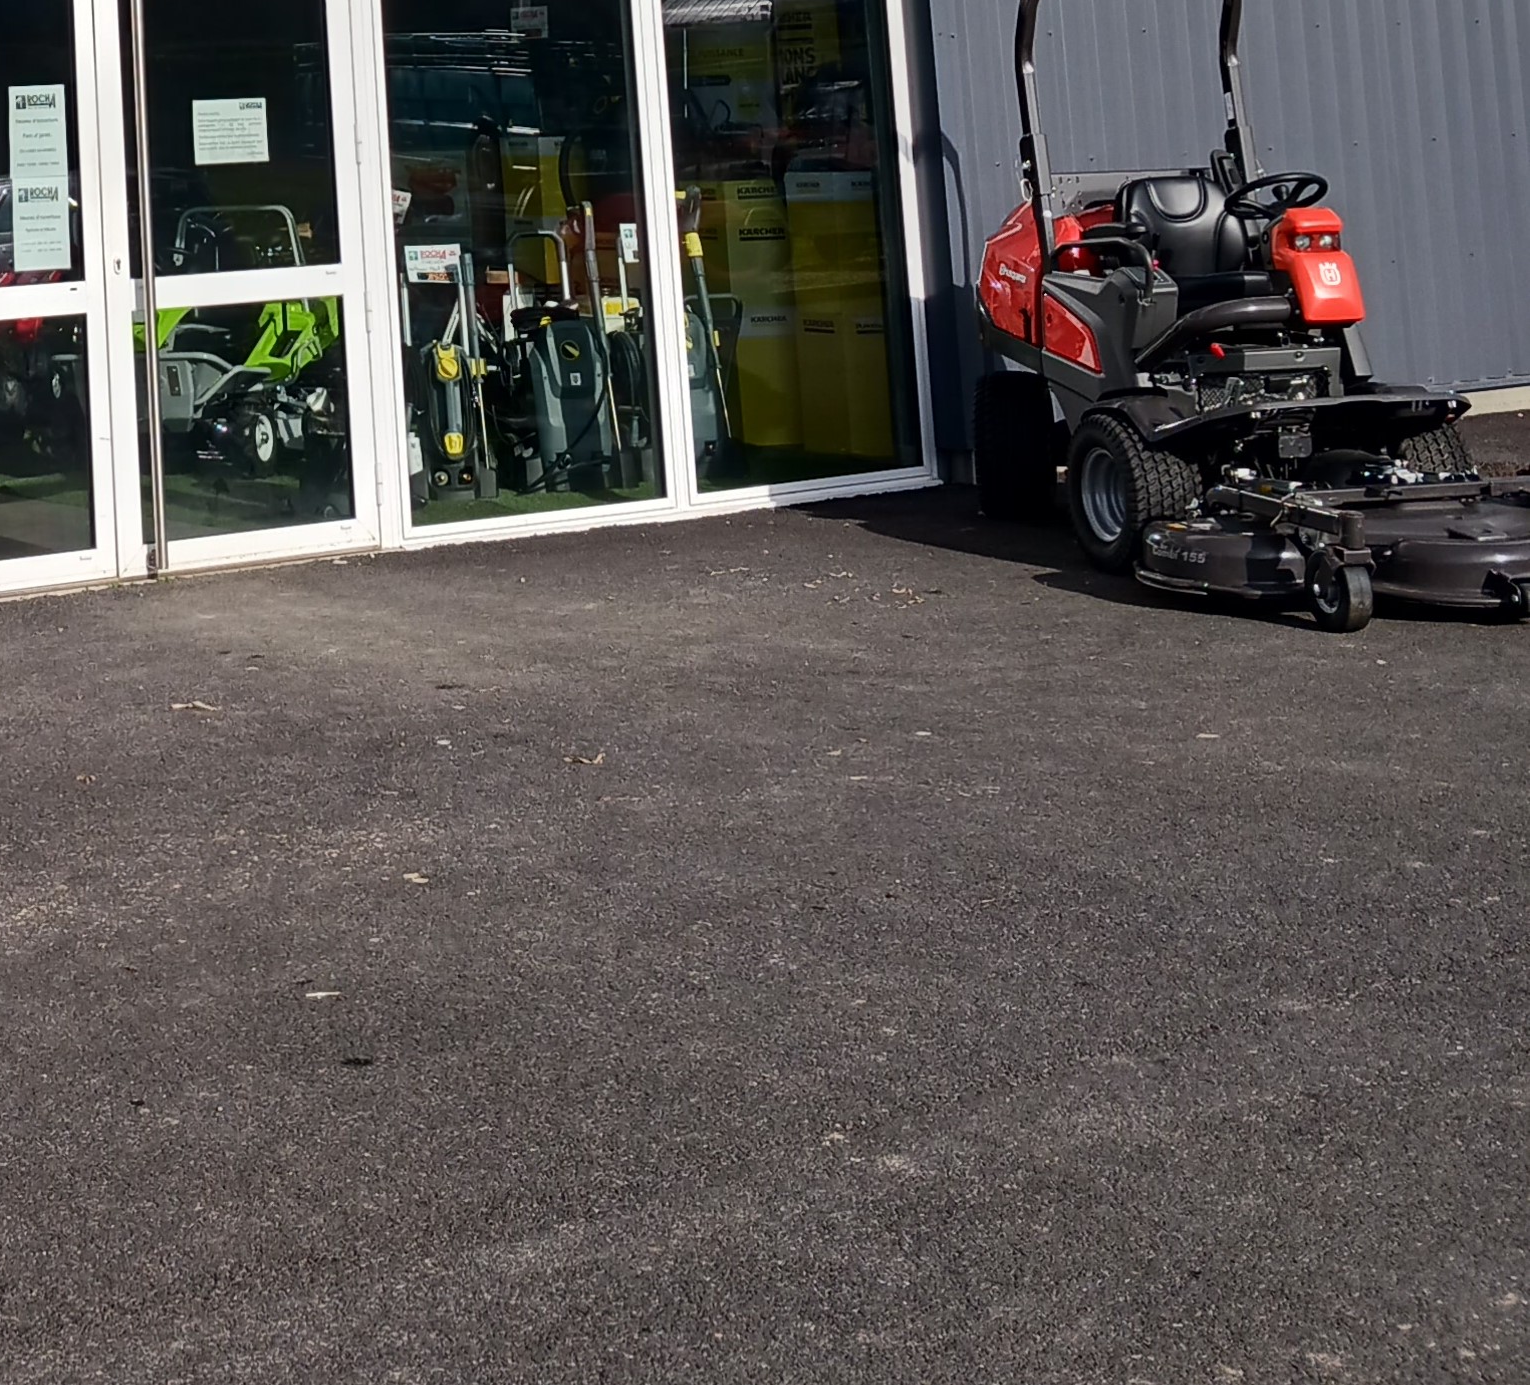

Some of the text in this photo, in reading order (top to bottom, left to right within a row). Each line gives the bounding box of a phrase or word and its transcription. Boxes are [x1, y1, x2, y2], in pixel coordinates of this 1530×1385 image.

[26, 92, 56, 108] ROCHA
[30, 186, 59, 202] ROCHA
[1181, 550, 1208, 564] 155
